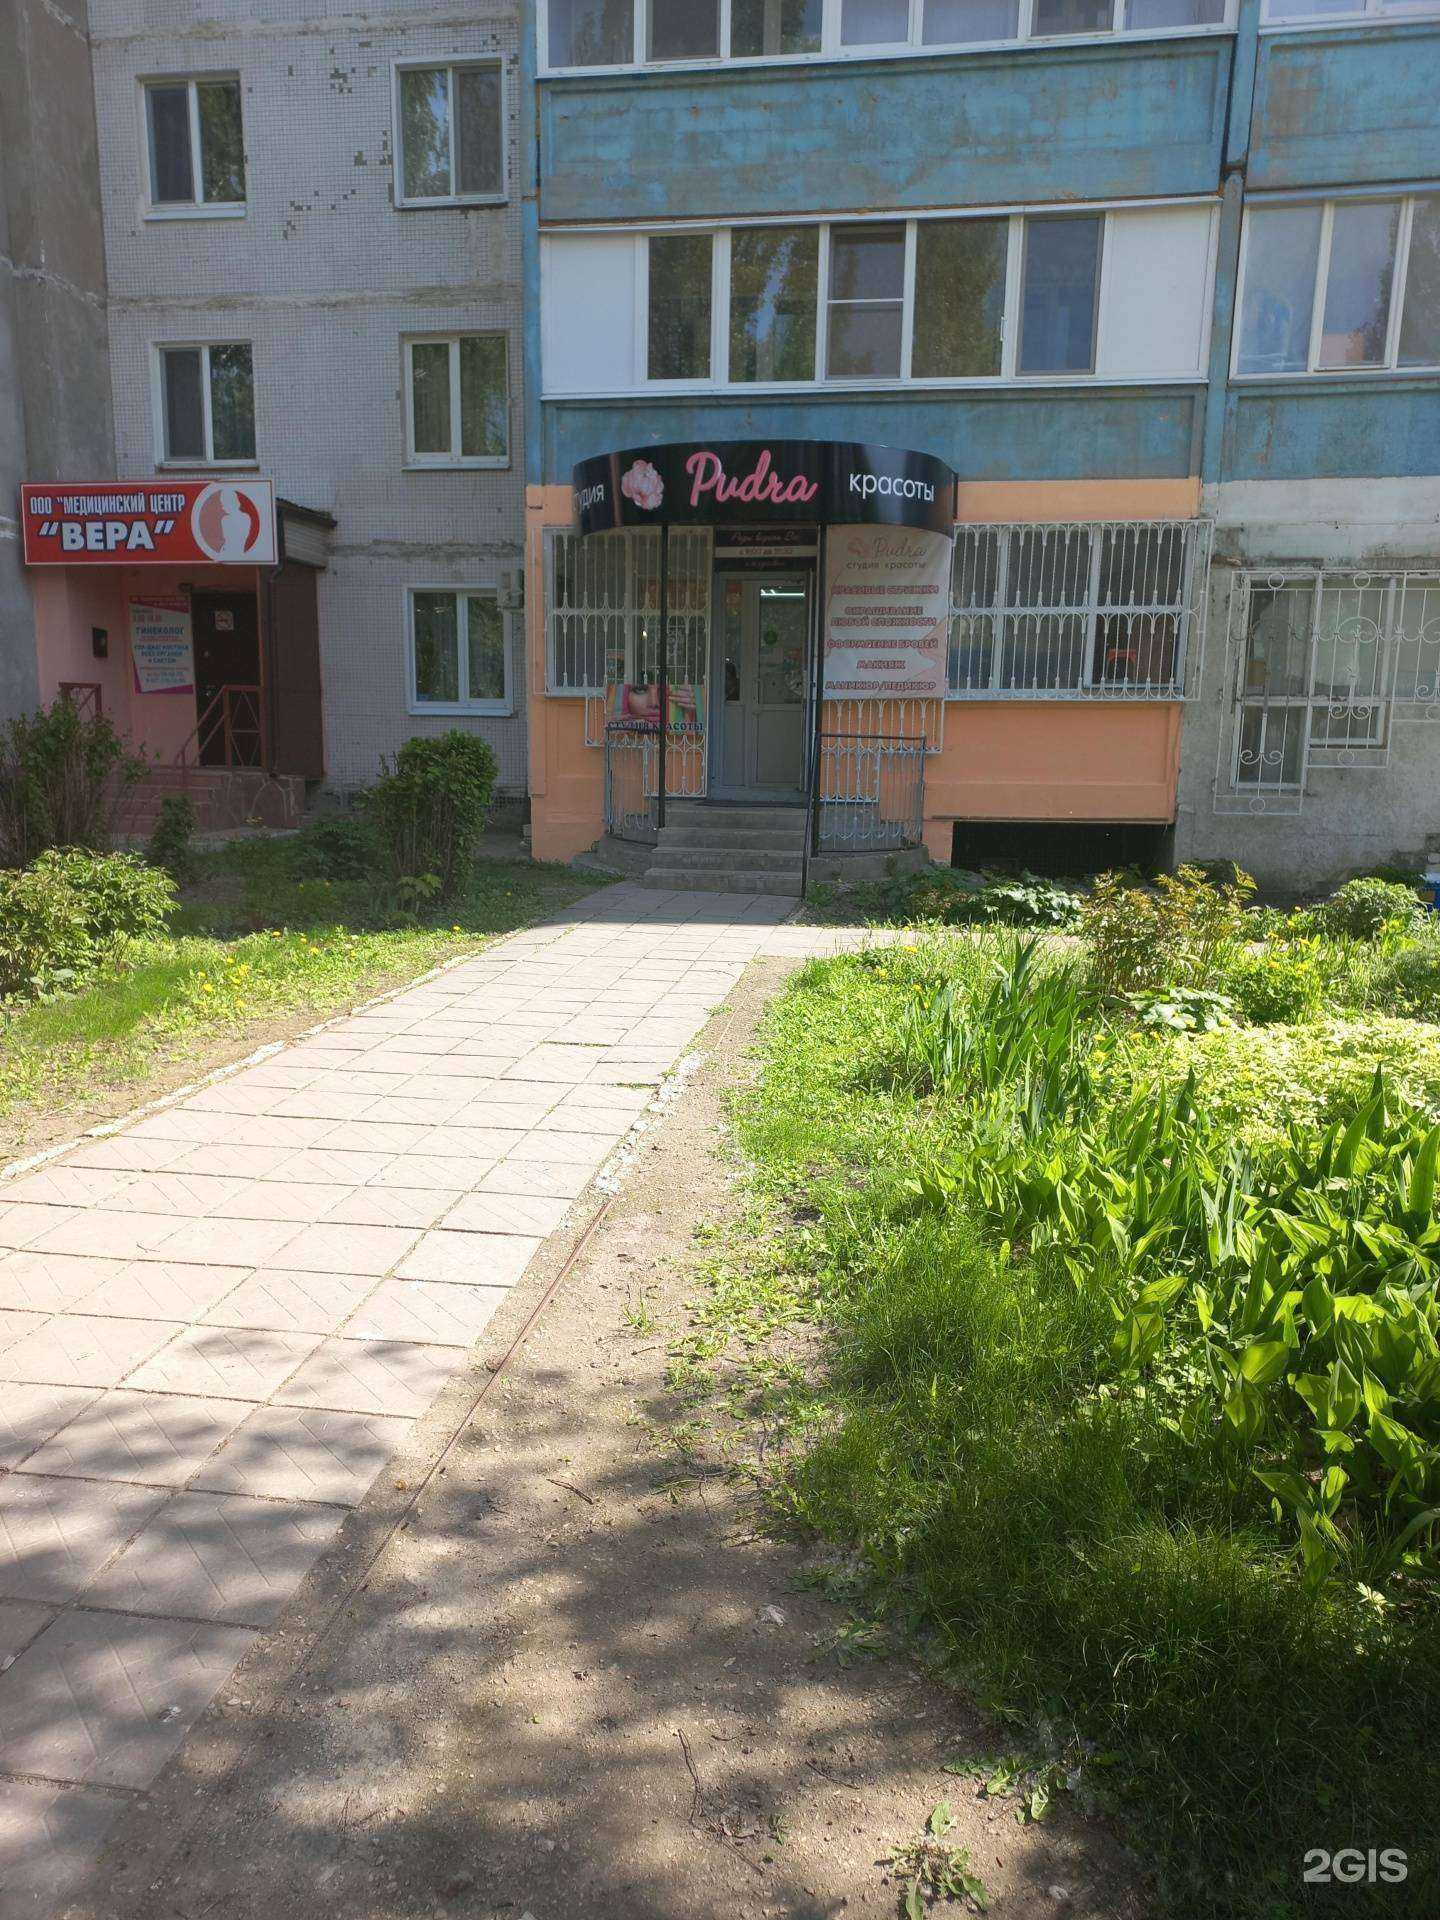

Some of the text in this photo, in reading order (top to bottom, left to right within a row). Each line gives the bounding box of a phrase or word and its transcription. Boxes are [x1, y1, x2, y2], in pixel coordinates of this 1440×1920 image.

[685, 449, 822, 508] Pudra
[30, 496, 52, 515] ООО
[150, 493, 186, 515] ЦЕНТР
[573, 473, 935, 515] тудия красоты
[39, 519, 175, 551] "ВЕРА"
[873, 537, 929, 558] Pudra
[846, 561, 928, 571] студия красоты
